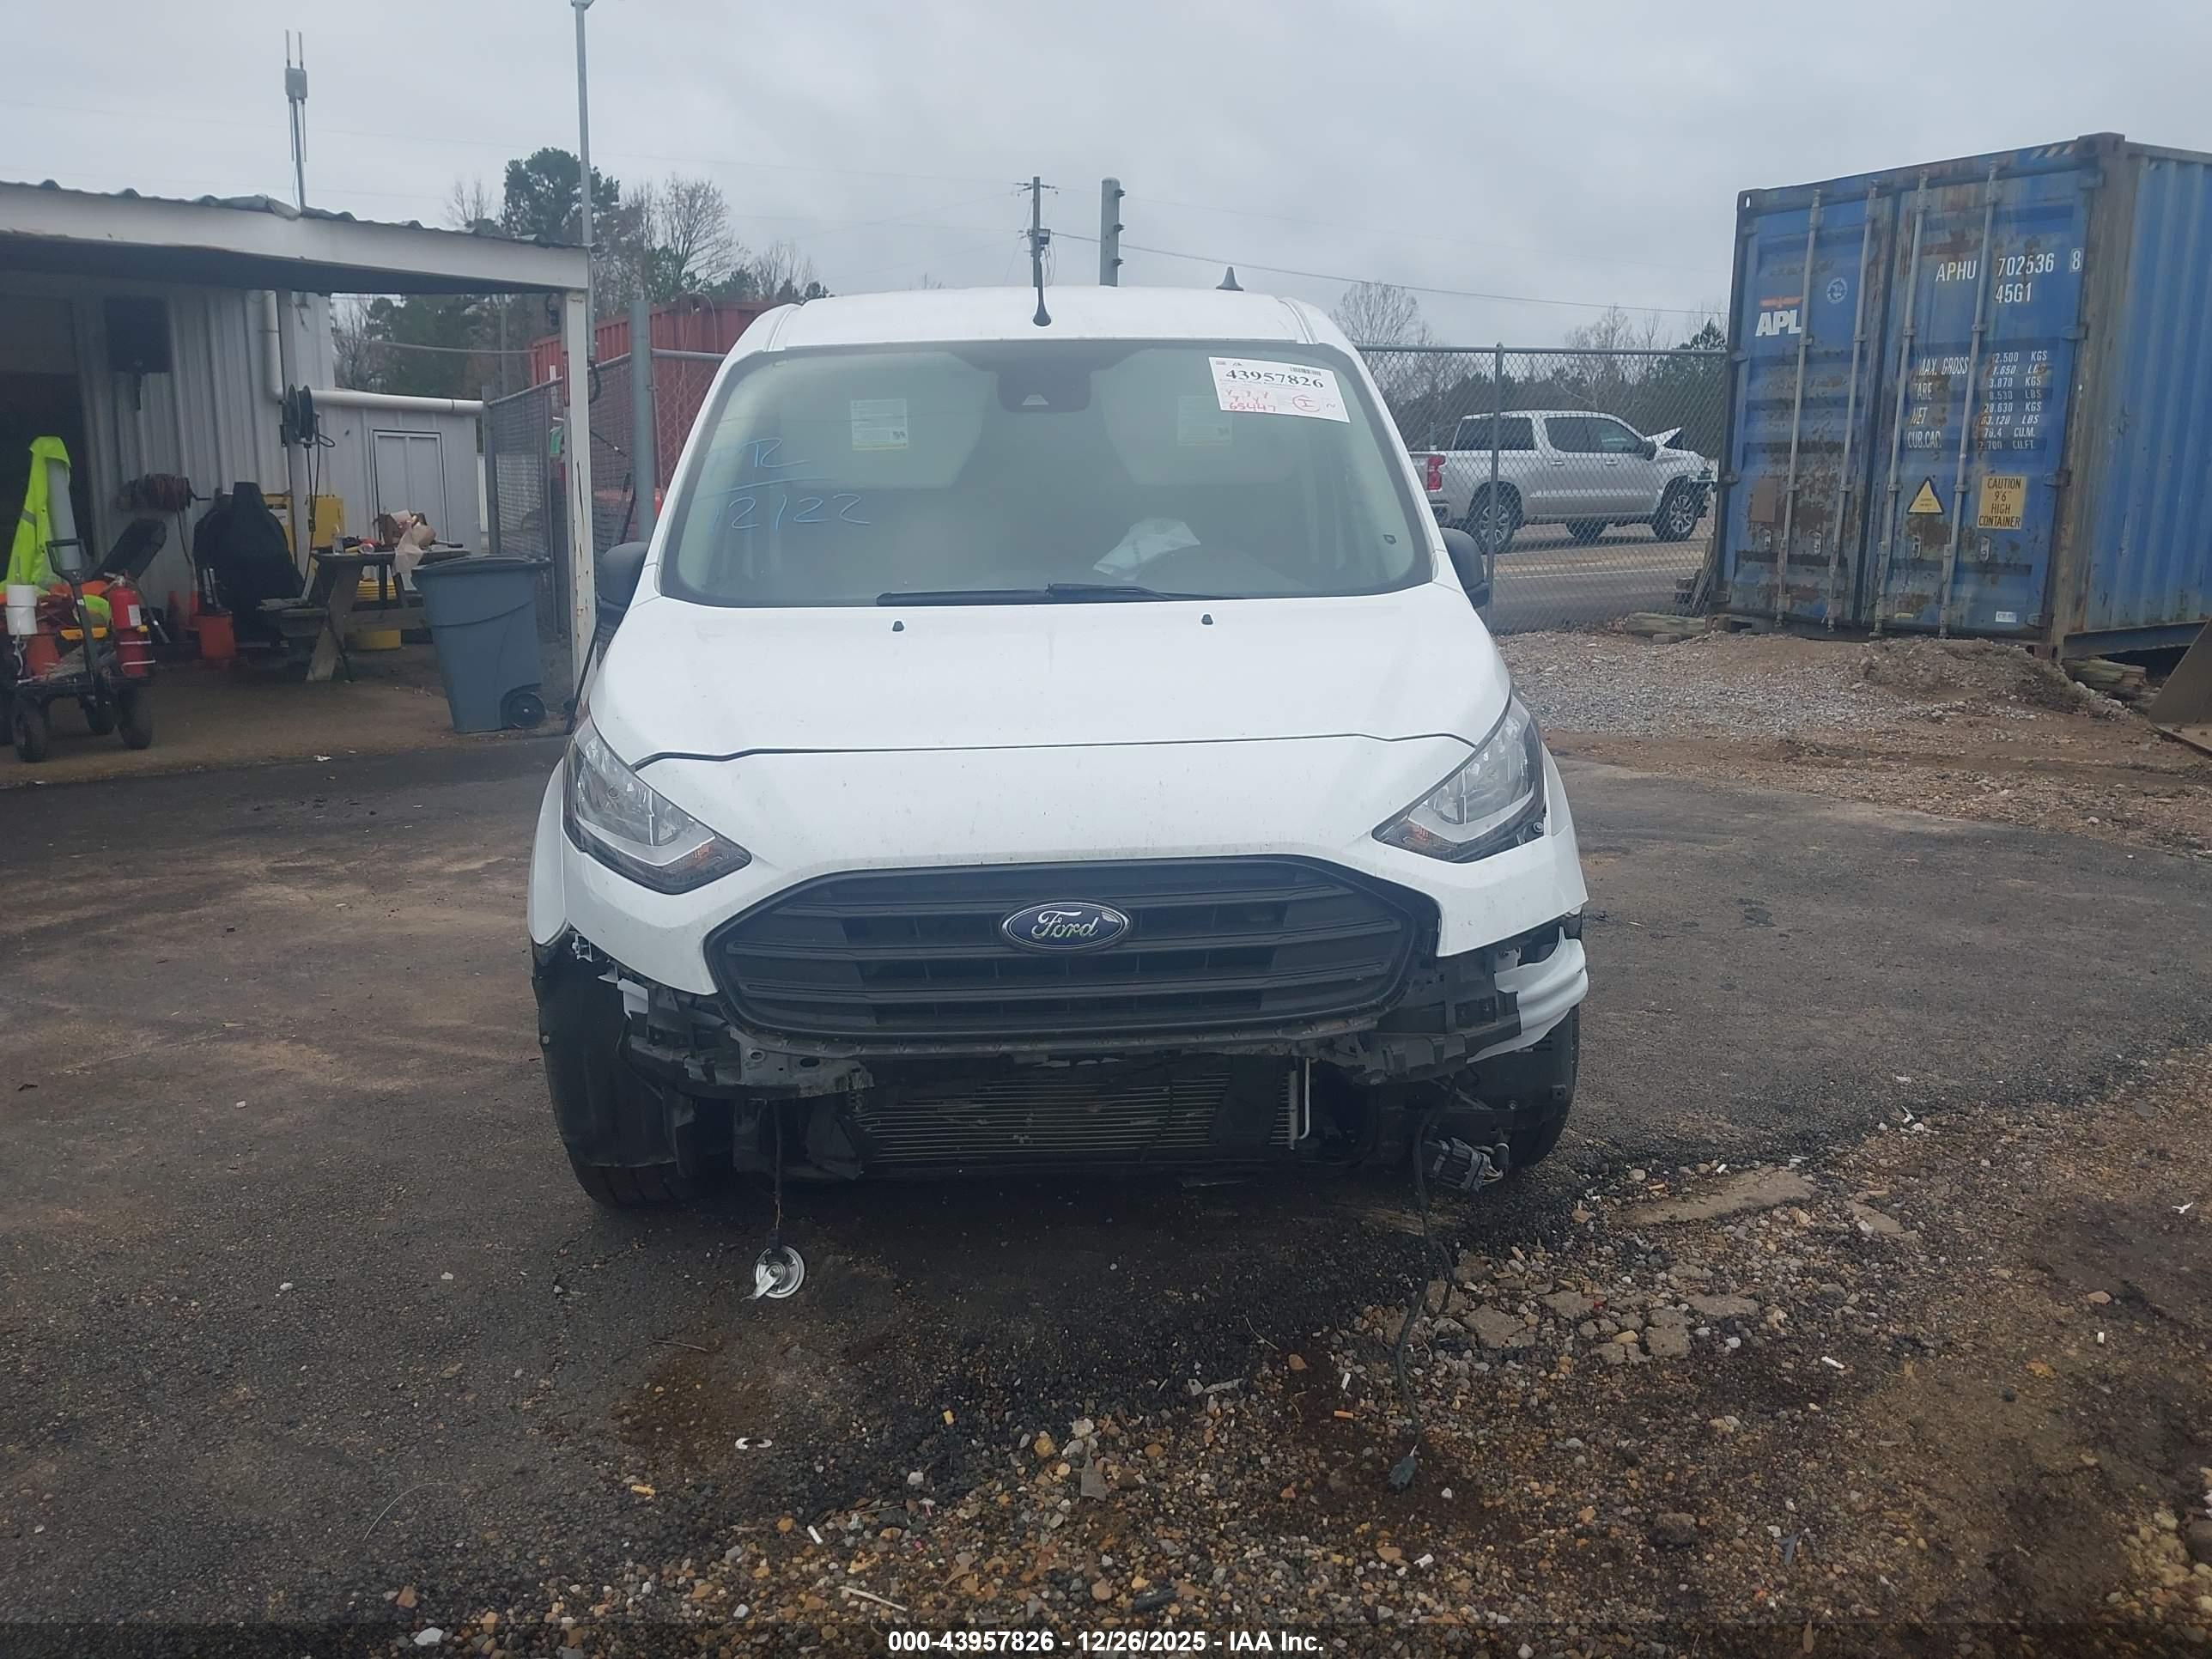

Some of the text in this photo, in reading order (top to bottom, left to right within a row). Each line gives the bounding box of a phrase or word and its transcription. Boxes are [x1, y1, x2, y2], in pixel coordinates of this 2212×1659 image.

[1936, 250, 2081, 282] APHU 702536 8
[1996, 283, 2033, 303] 45G1
[1755, 309, 1802, 337] APL
[2031, 350, 2047, 362] KGS
[1942, 356, 1969, 375] GROSS
[1992, 365, 2017, 375] 1.650
[1225, 369, 1324, 388] 43957826
[2025, 376, 2041, 387] KGS
[2025, 401, 2042, 412] KGS
[2021, 414, 2039, 424] LBS
[1987, 477, 2021, 489] CAUTION
[1990, 503, 2011, 514] HIGH
[1978, 515, 2021, 527] CONTAINER
[1031, 910, 1100, 939] Ford
